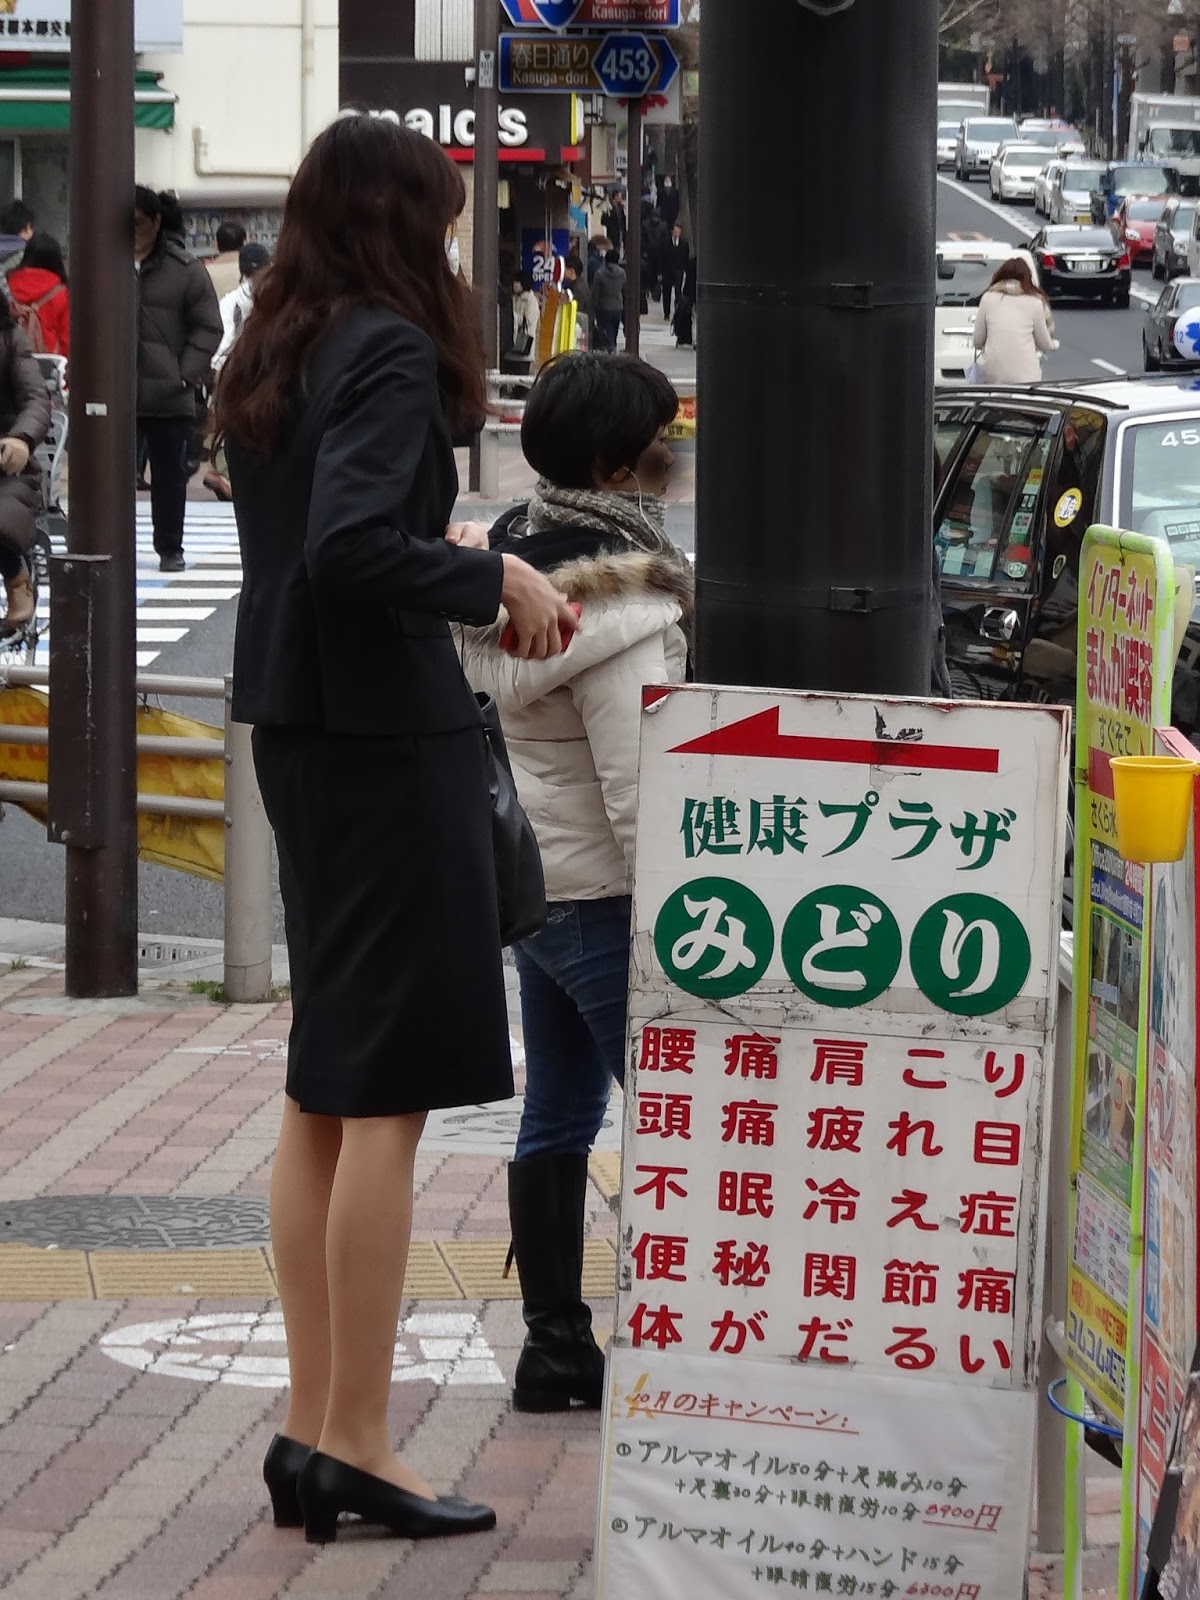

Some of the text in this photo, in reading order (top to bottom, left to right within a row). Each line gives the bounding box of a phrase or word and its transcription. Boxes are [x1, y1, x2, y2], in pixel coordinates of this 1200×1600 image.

[592, 4, 667, 21] Kasuga-dori
[512, 43, 590, 69] 春日通り
[601, 47, 650, 82] 453
[512, 69, 589, 86] Kasuga-dori
[532, 255, 555, 273] 24
[1088, 560, 1154, 632] インターネット
[1086, 627, 1153, 724] まんが喫茶
[678, 790, 1017, 871] 健康プラザ
[670, 894, 1001, 999] みどり
